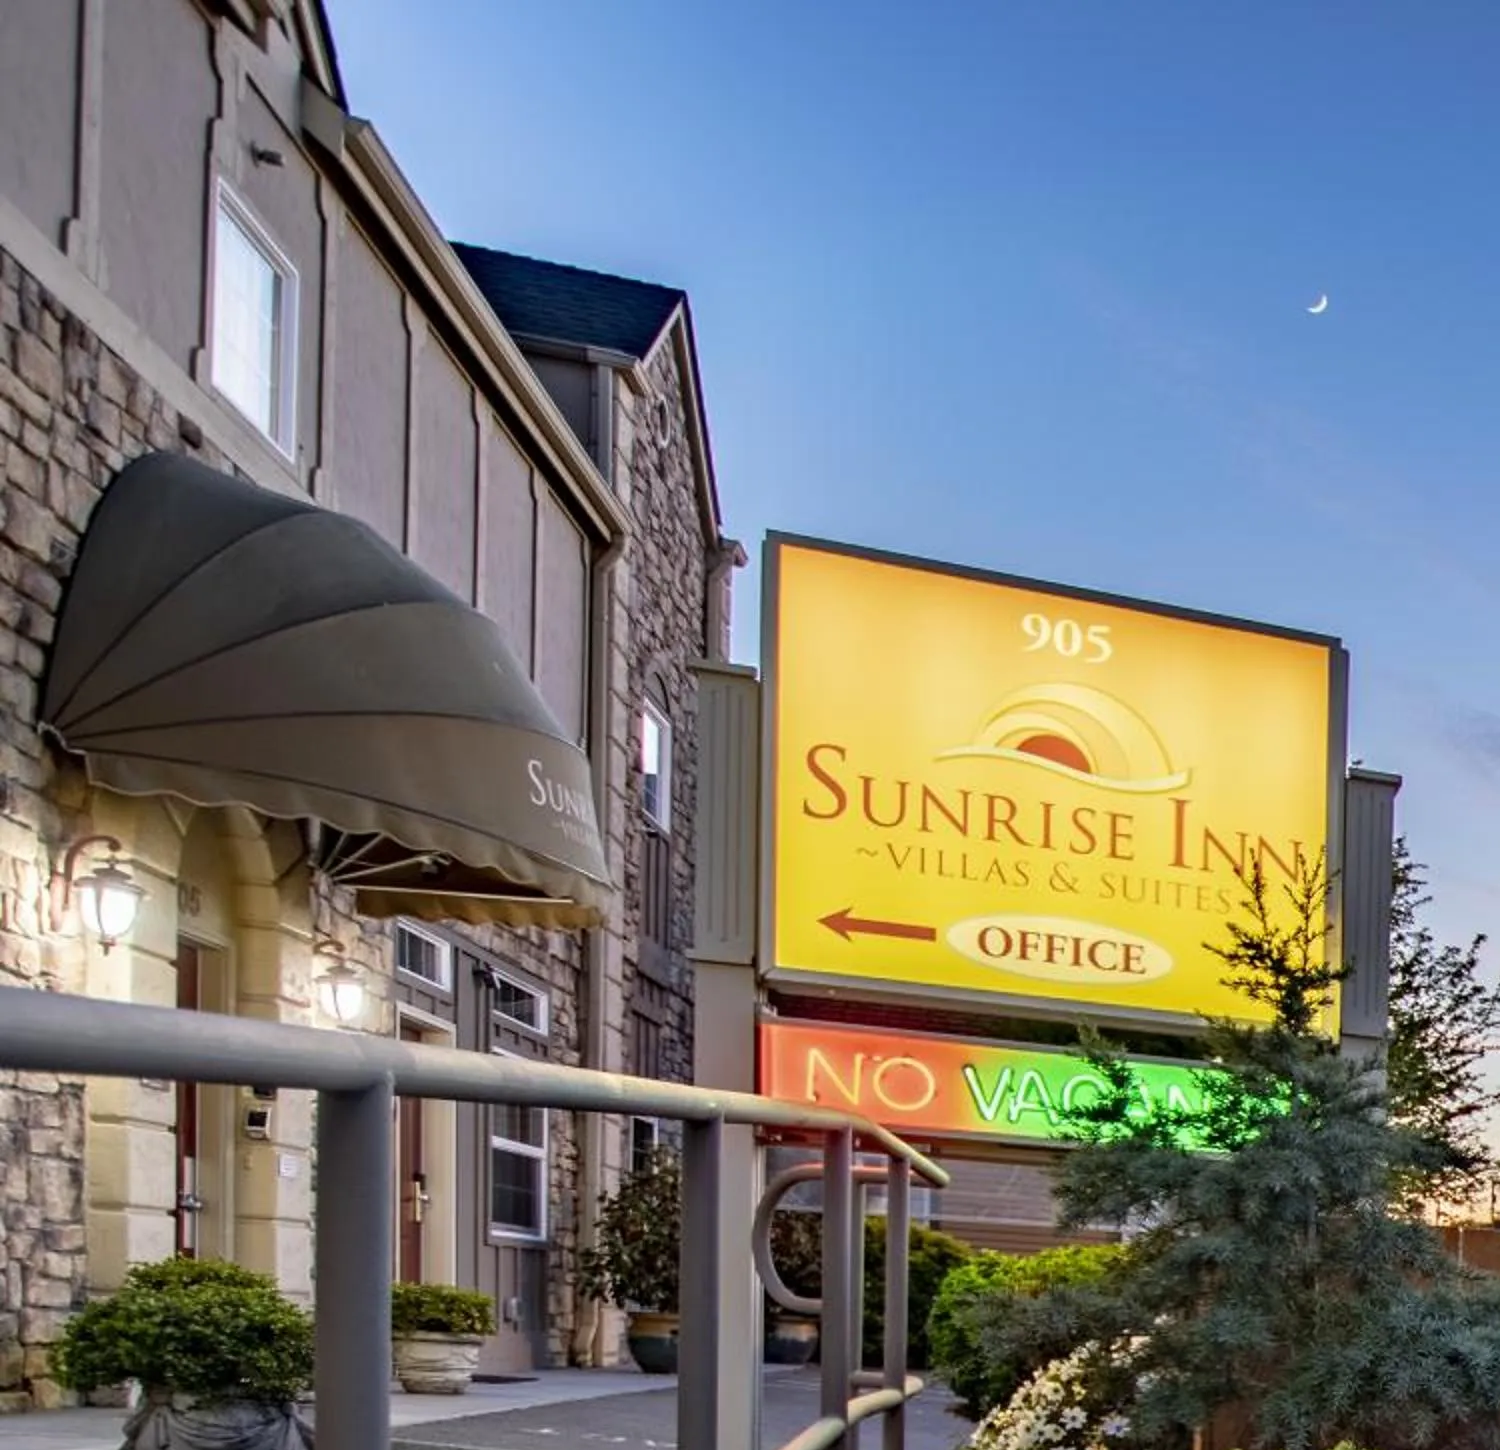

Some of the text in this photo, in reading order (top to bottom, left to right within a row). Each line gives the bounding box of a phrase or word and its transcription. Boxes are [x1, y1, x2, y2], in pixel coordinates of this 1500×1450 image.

[1021, 613, 1113, 664] 905
[802, 742, 1303, 885] SUNRISE INN
[1048, 861, 1080, 895] &
[977, 925, 1147, 975] OFFICE
[806, 1047, 936, 1111] NO
